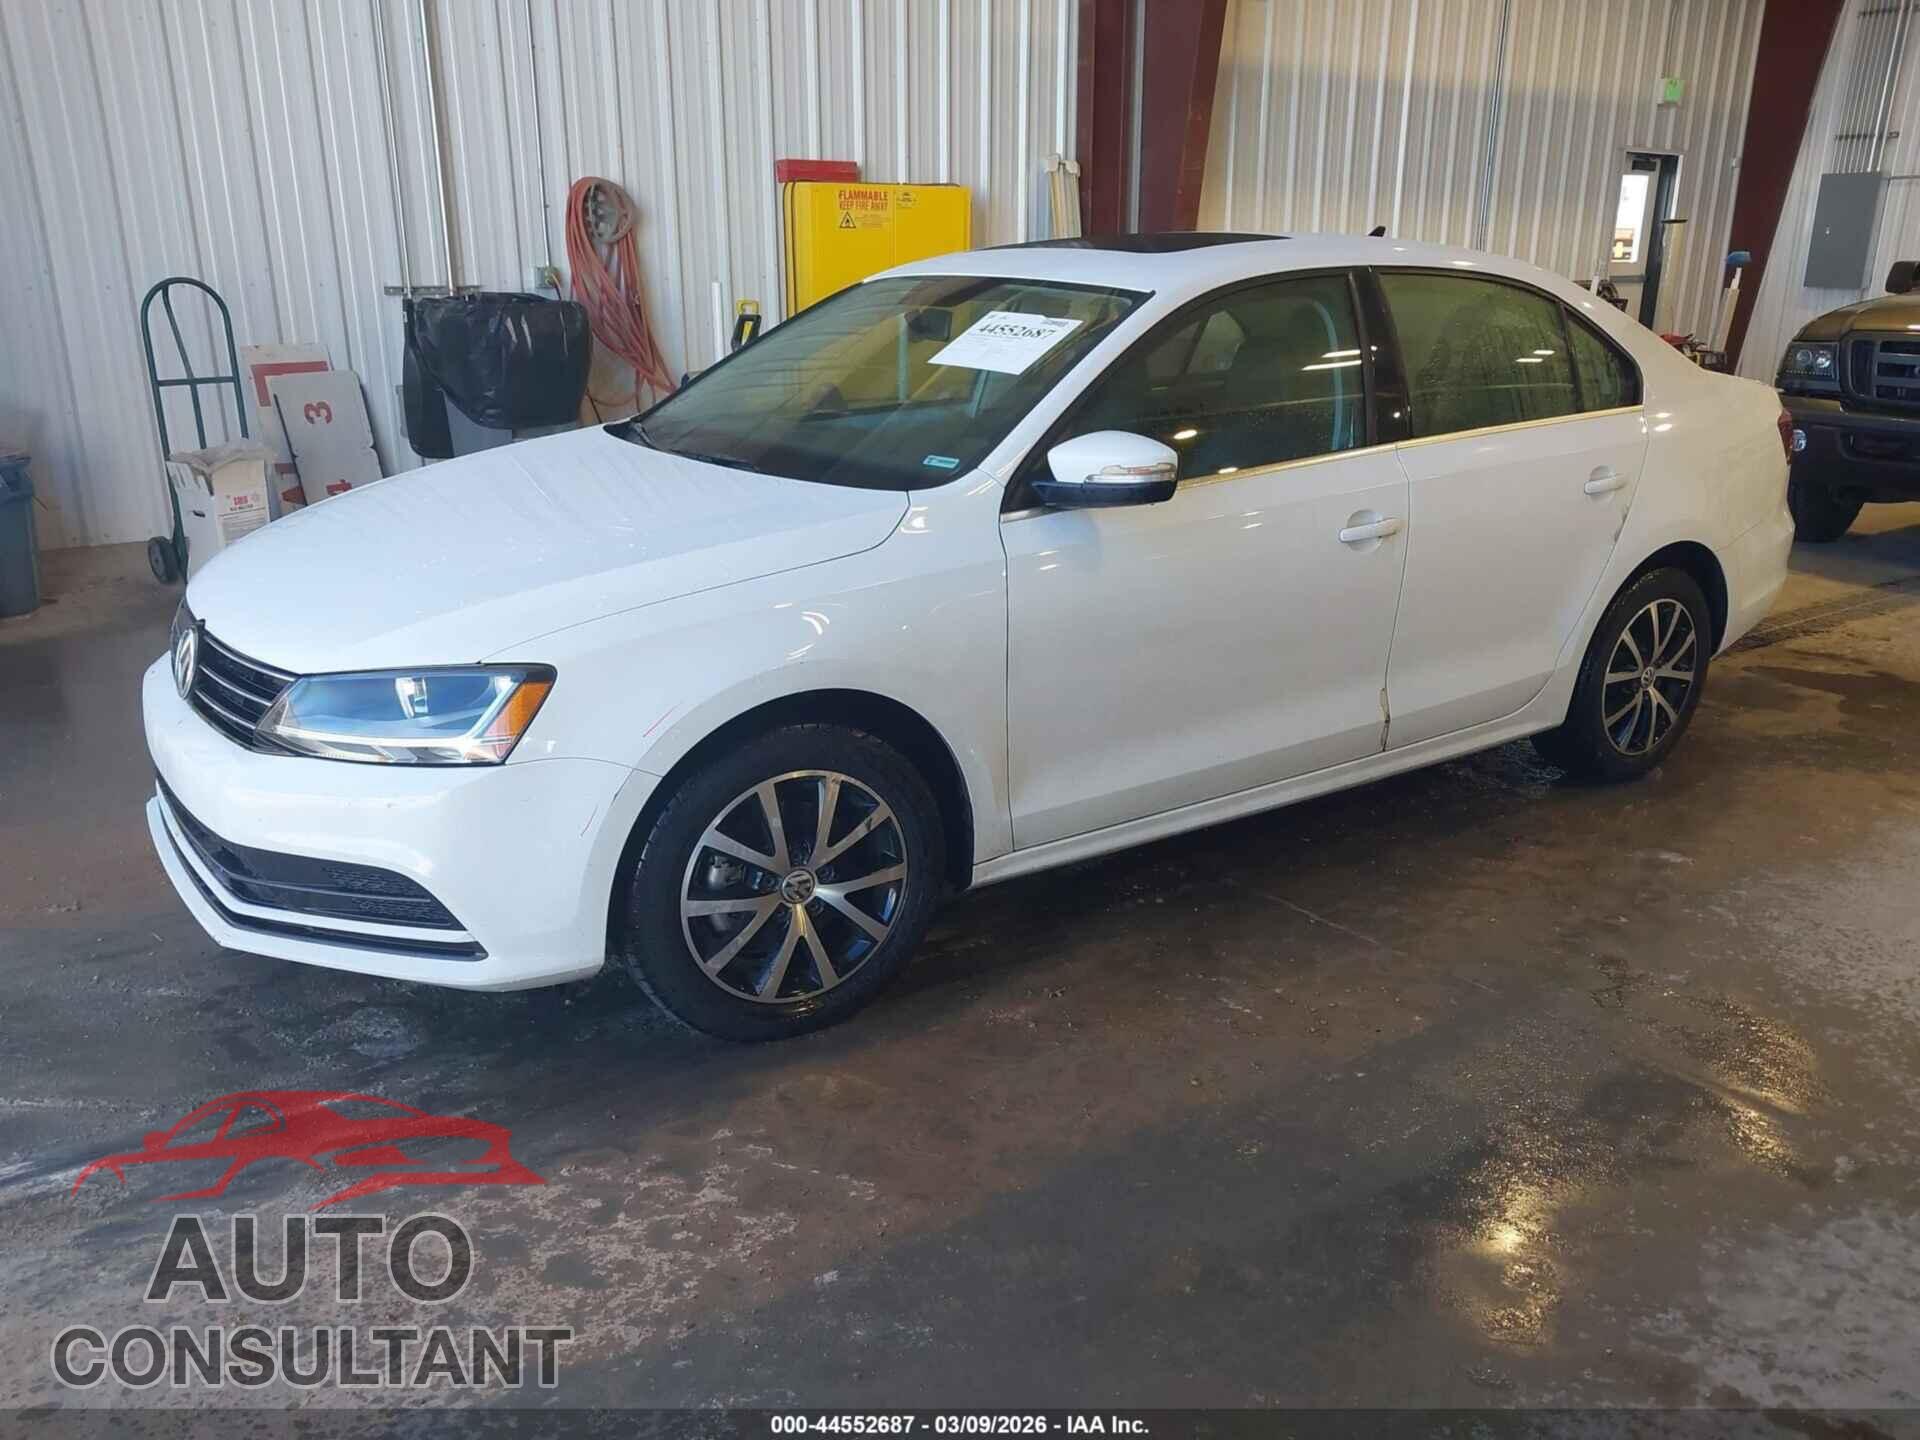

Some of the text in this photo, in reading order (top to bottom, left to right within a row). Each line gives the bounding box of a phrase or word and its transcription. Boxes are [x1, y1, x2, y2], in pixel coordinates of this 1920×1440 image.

[838, 190, 888, 200] FLAMMABLE
[839, 200, 888, 210] KEEP FIRE AWAY
[977, 323, 1056, 338] 44552687
